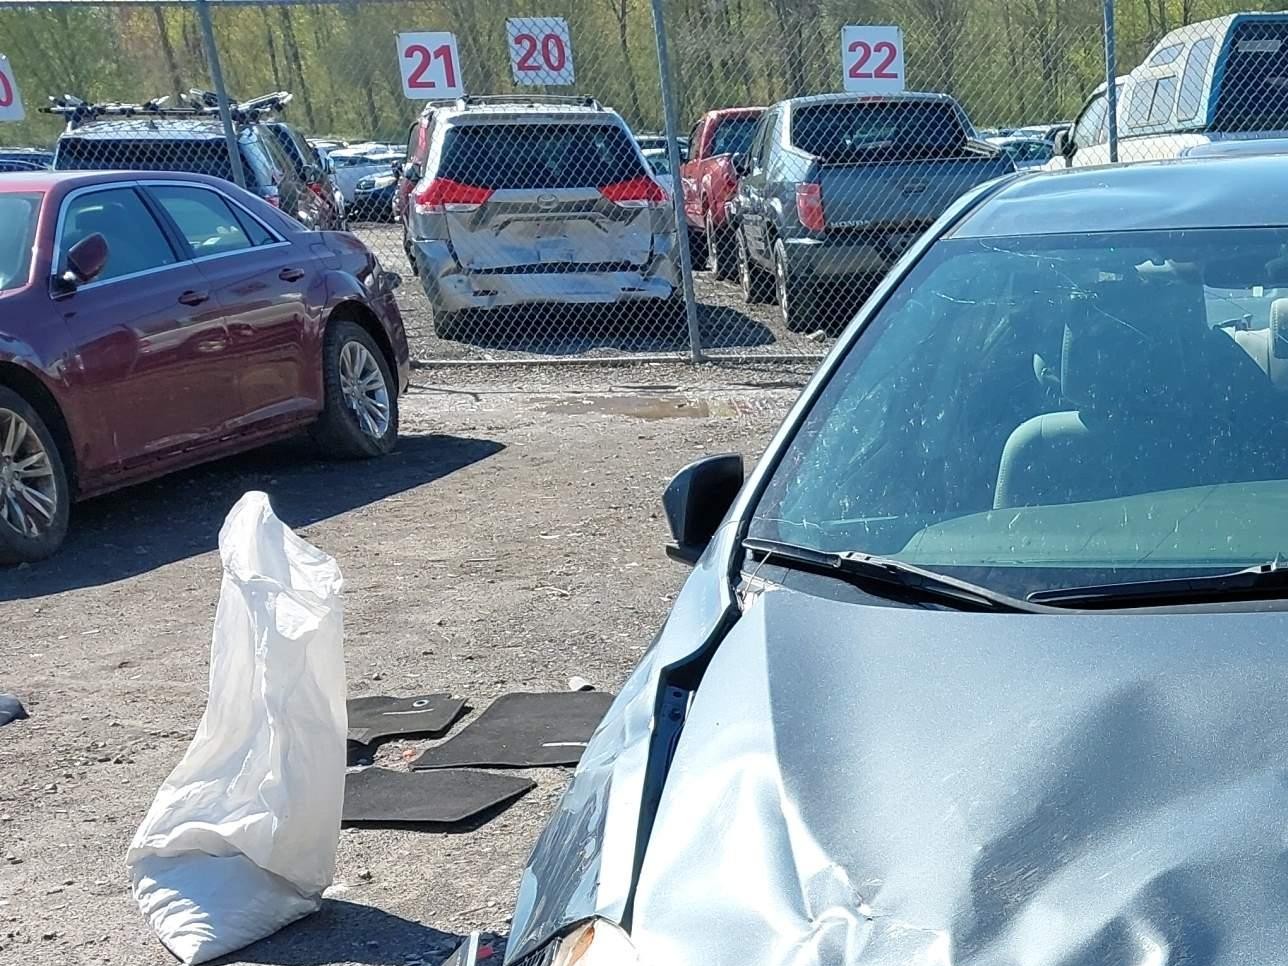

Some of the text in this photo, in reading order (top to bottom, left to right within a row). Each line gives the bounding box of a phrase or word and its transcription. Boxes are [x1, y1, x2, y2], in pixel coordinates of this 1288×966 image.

[404, 44, 456, 88] 21
[513, 33, 565, 72] 20
[848, 41, 898, 78] 22
